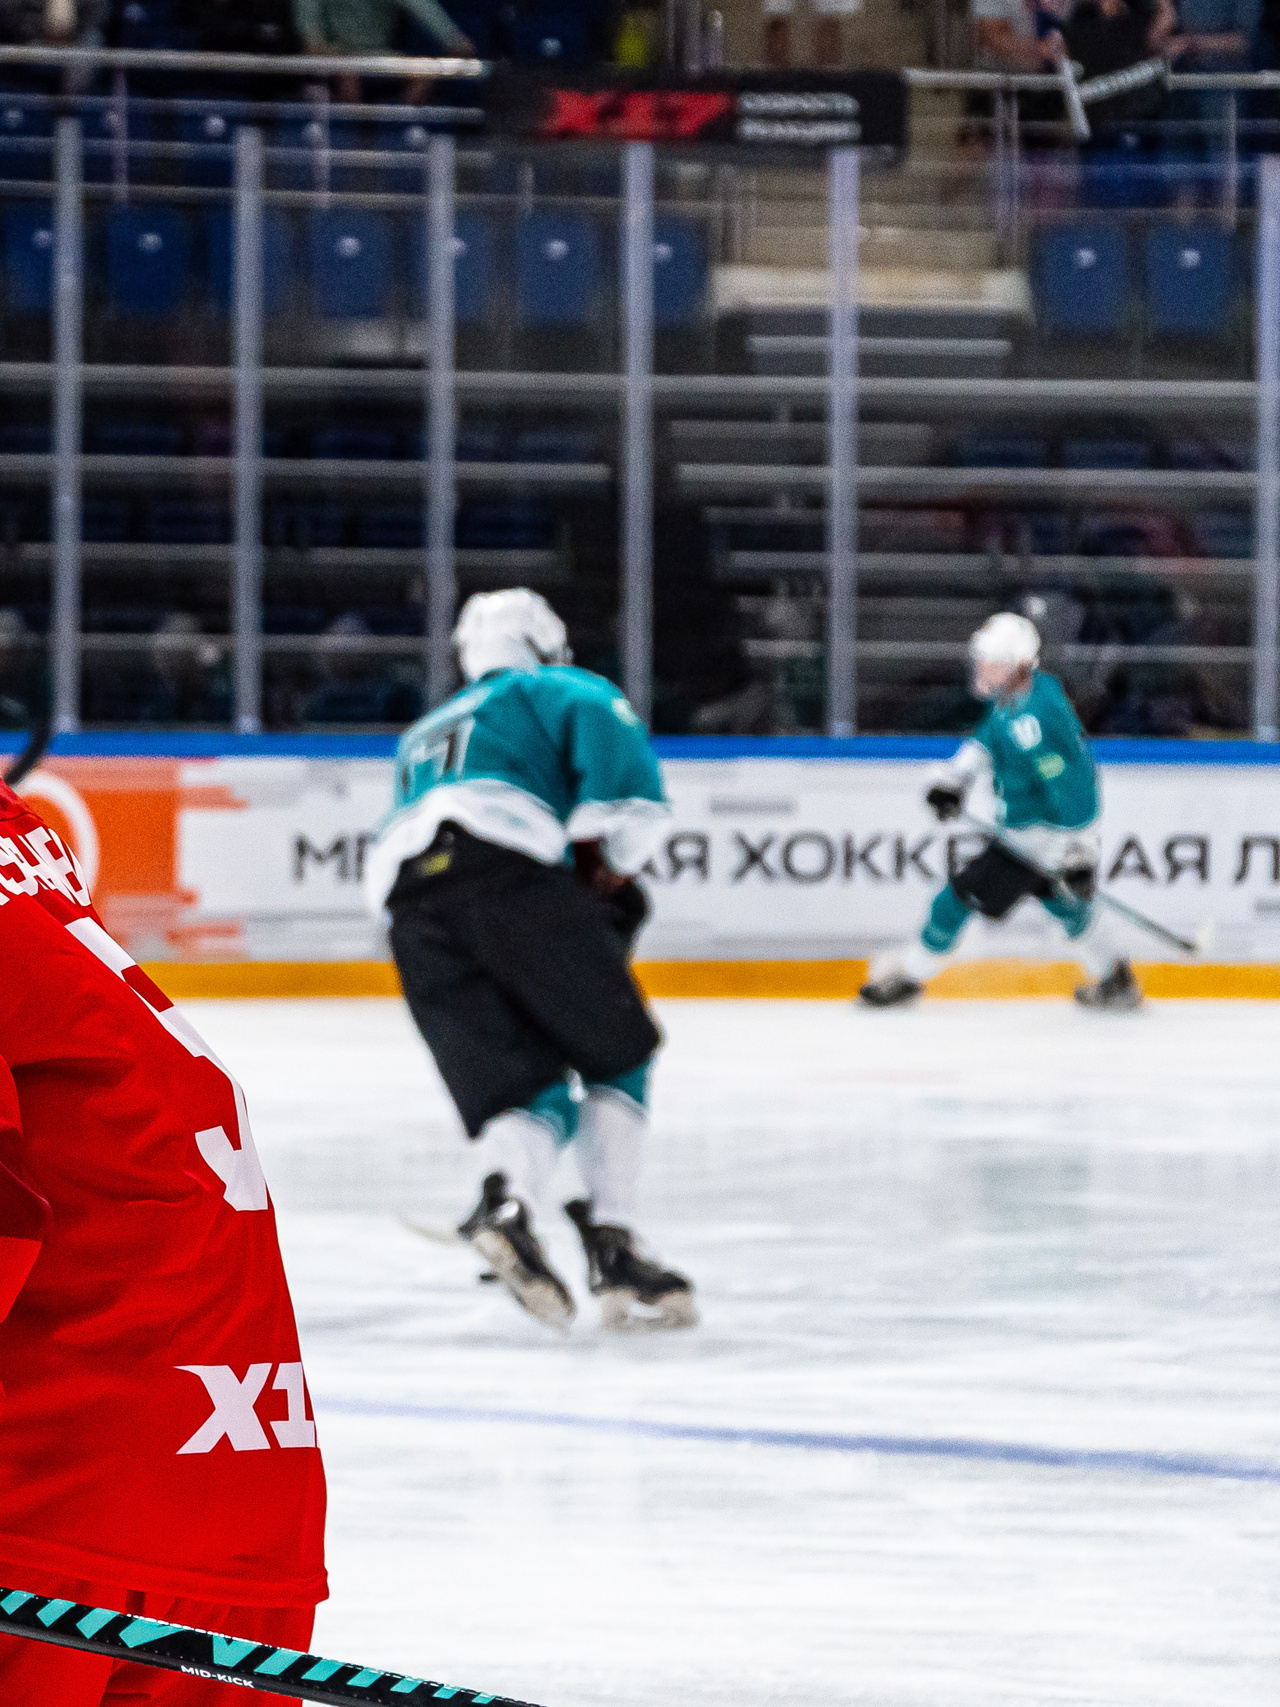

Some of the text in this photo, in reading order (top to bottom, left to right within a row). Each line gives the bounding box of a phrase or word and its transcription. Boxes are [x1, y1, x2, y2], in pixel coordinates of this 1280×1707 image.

[730, 830, 1210, 885] ХОККЕАЯ
[172, 1361, 316, 1455] X1
[180, 1664, 255, 1689] MID-KICK
